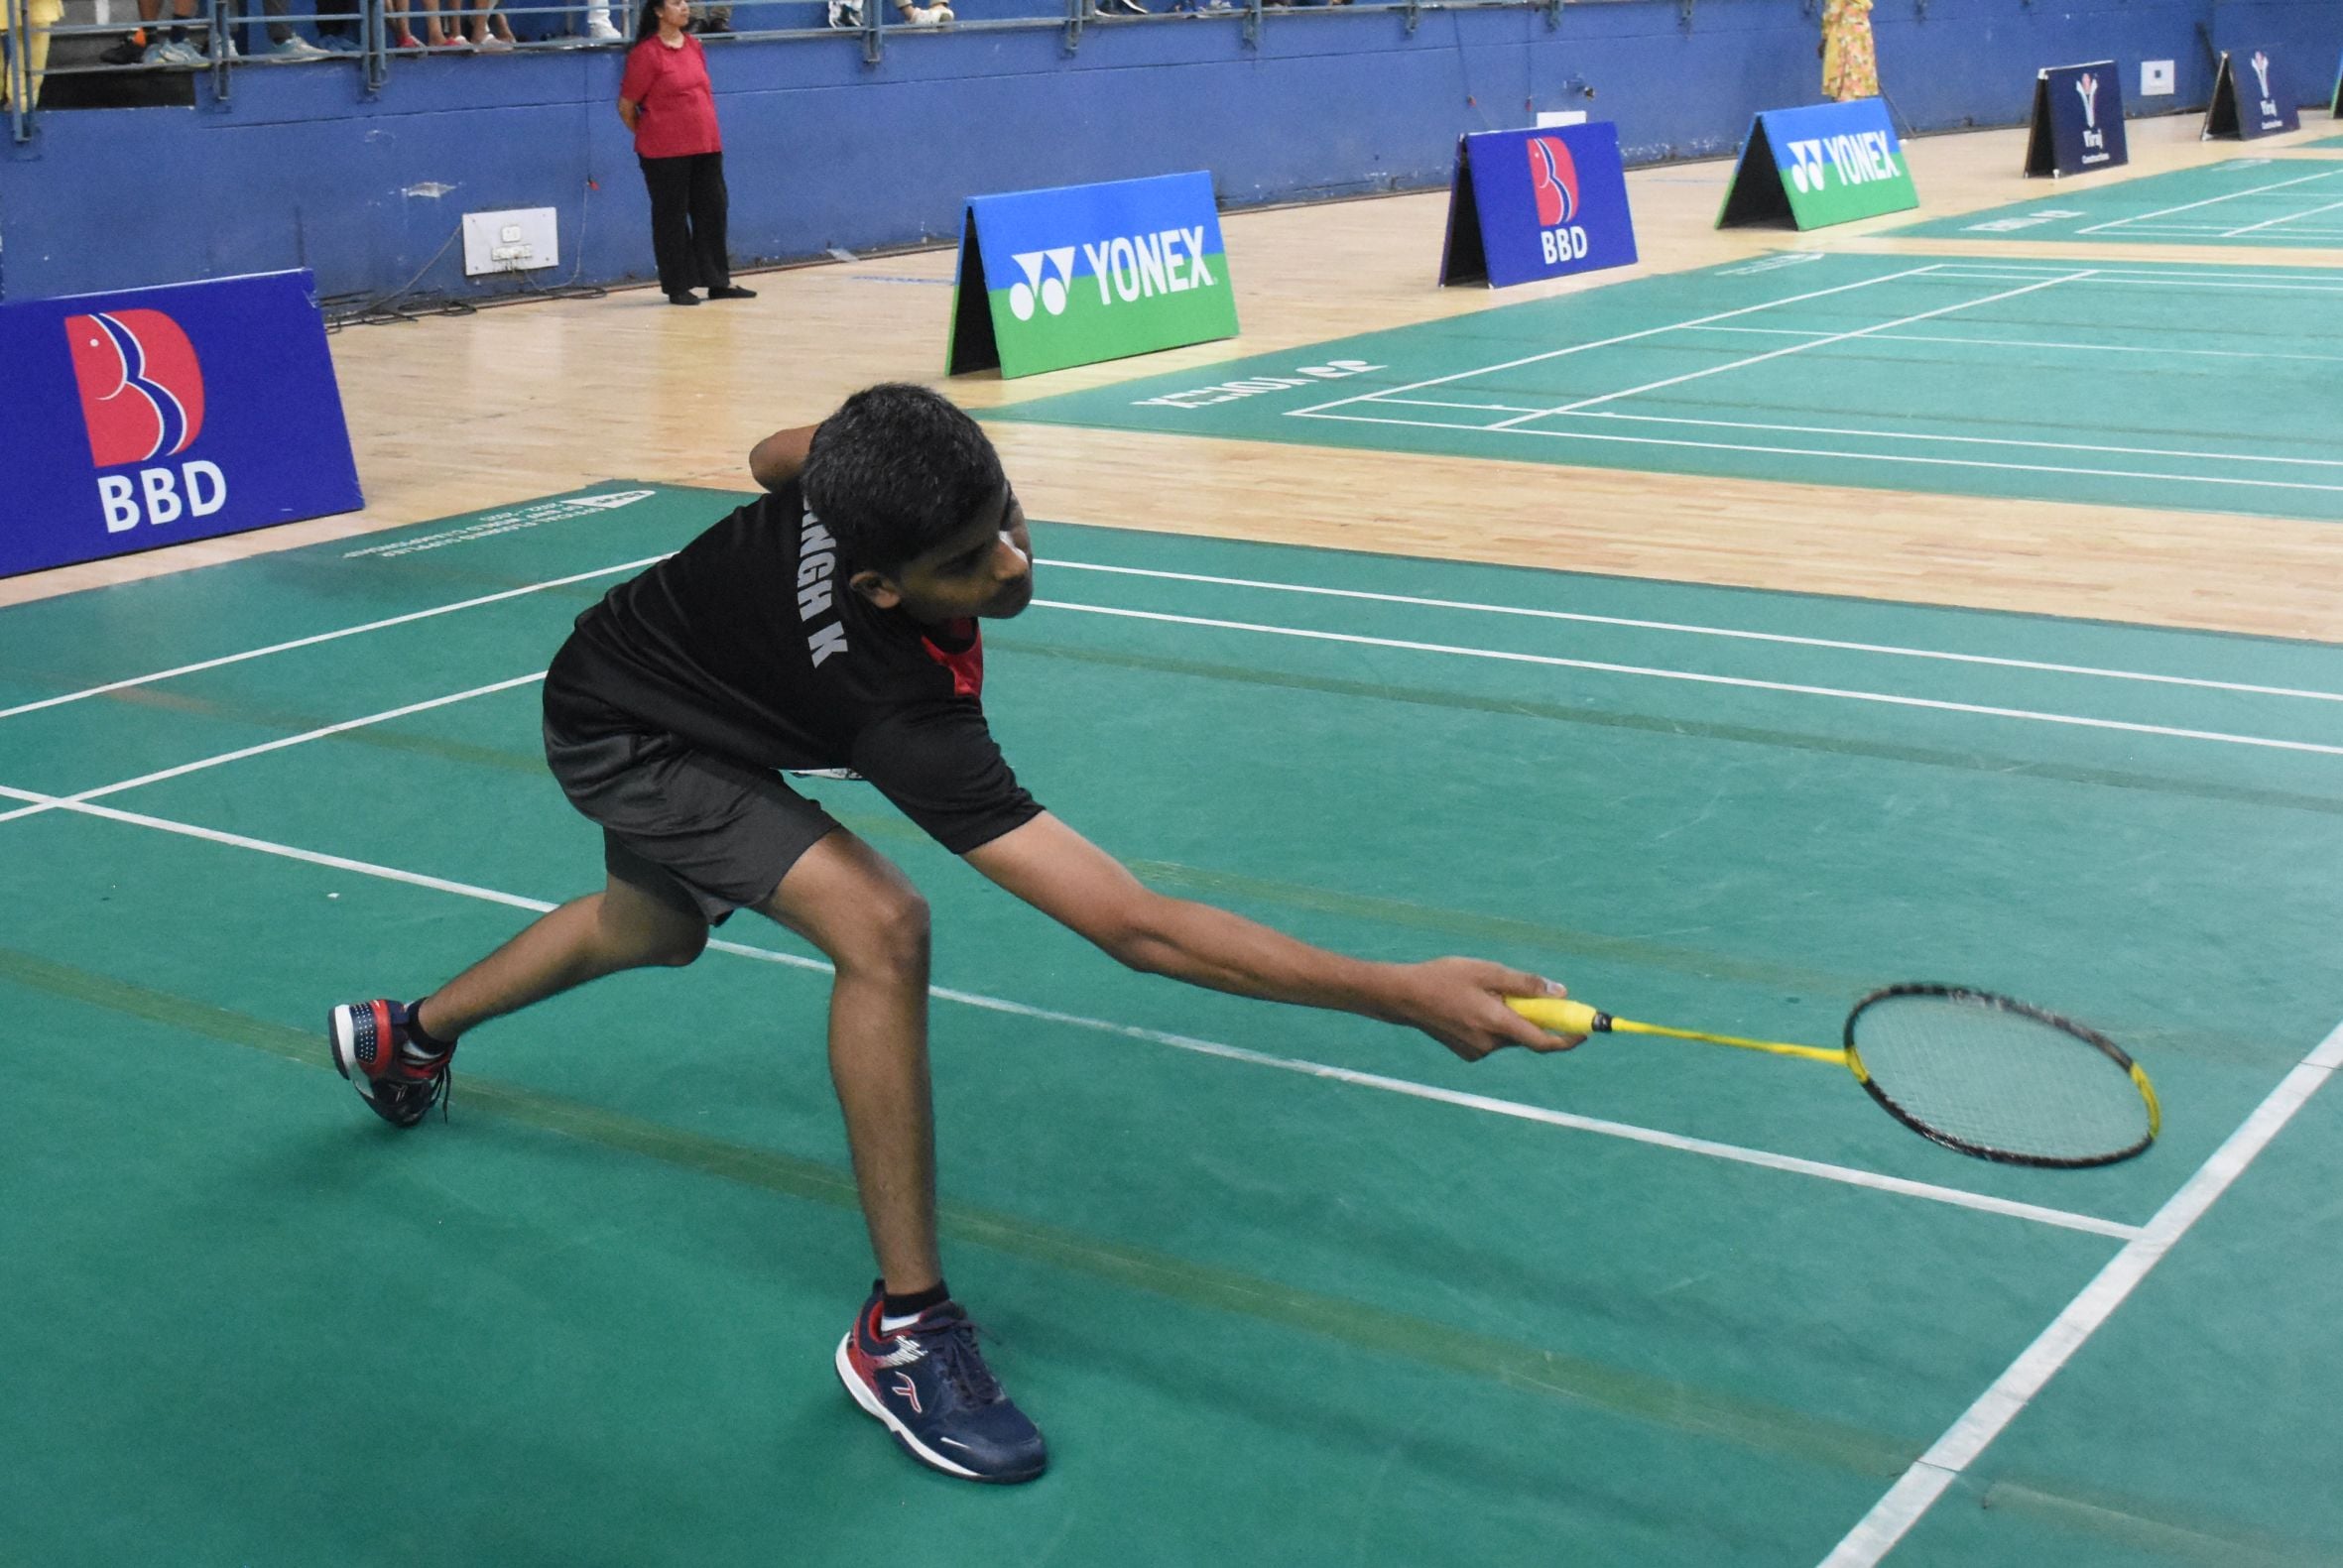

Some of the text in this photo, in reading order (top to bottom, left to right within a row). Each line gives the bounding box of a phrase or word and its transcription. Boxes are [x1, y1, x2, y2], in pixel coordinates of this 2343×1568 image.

[1823, 130, 1900, 185] YONEX
[1083, 225, 1216, 305] YONEX
[1541, 226, 1587, 265] BBD
[98, 460, 227, 533] BBD
[798, 496, 849, 669] NGH K
